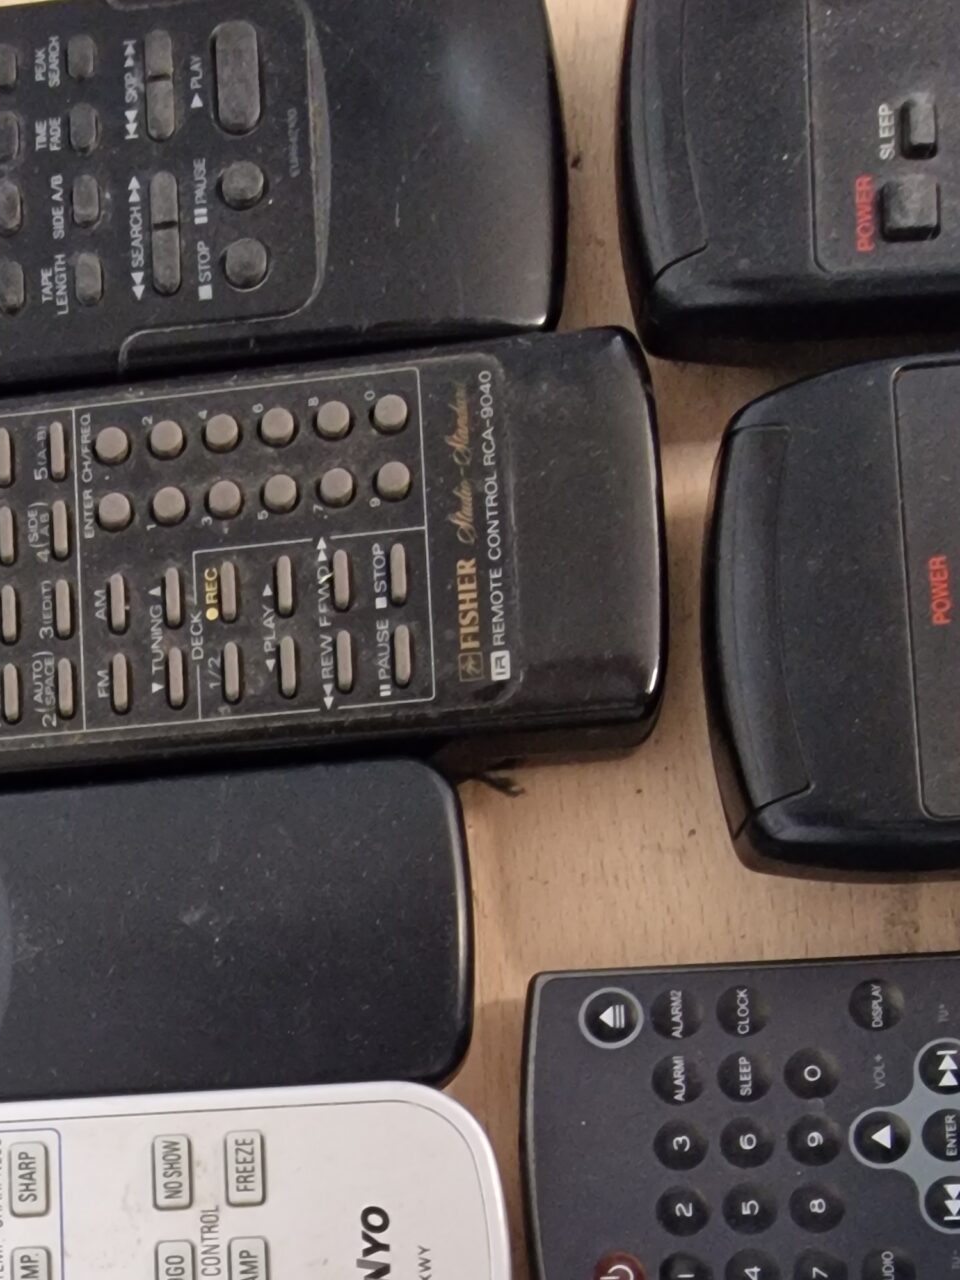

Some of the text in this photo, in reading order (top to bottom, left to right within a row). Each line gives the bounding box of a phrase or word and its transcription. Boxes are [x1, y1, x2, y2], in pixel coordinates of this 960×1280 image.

[124, 72, 137, 103] SKIP
[190, 56, 202, 89] PLAY
[878, 104, 894, 159] SLEEP
[194, 158, 207, 204] PAUSE
[130, 206, 144, 267] SEARCH
[855, 175, 874, 250] POWER
[54, 254, 68, 315] LENGTH
[197, 241, 211, 282] STOP
[478, 371, 495, 466] RCA-9040
[80, 413, 94, 538] ENTER CH/FREQ
[484, 471, 501, 560] CONTROL
[204, 568, 217, 604] REC
[457, 559, 480, 649] FISHER
[489, 568, 505, 646] REMOTE
[928, 556, 951, 624] POWER
[150, 605, 164, 674] TUNING
[190, 611, 203, 660] DECK
[320, 635, 333, 679] REW
[376, 620, 390, 680] PAUSE
[670, 990, 683, 1038] ALARM2
[737, 989, 749, 1034] CLOCK
[872, 985, 883, 1027] DISPLAY
[739, 1057, 751, 1095] SLEEP
[945, 1115, 957, 1156] ENTER
[18, 1152, 37, 1202] SHARP
[162, 1141, 182, 1199] NO SHOW
[235, 1139, 255, 1192] FREEZE
